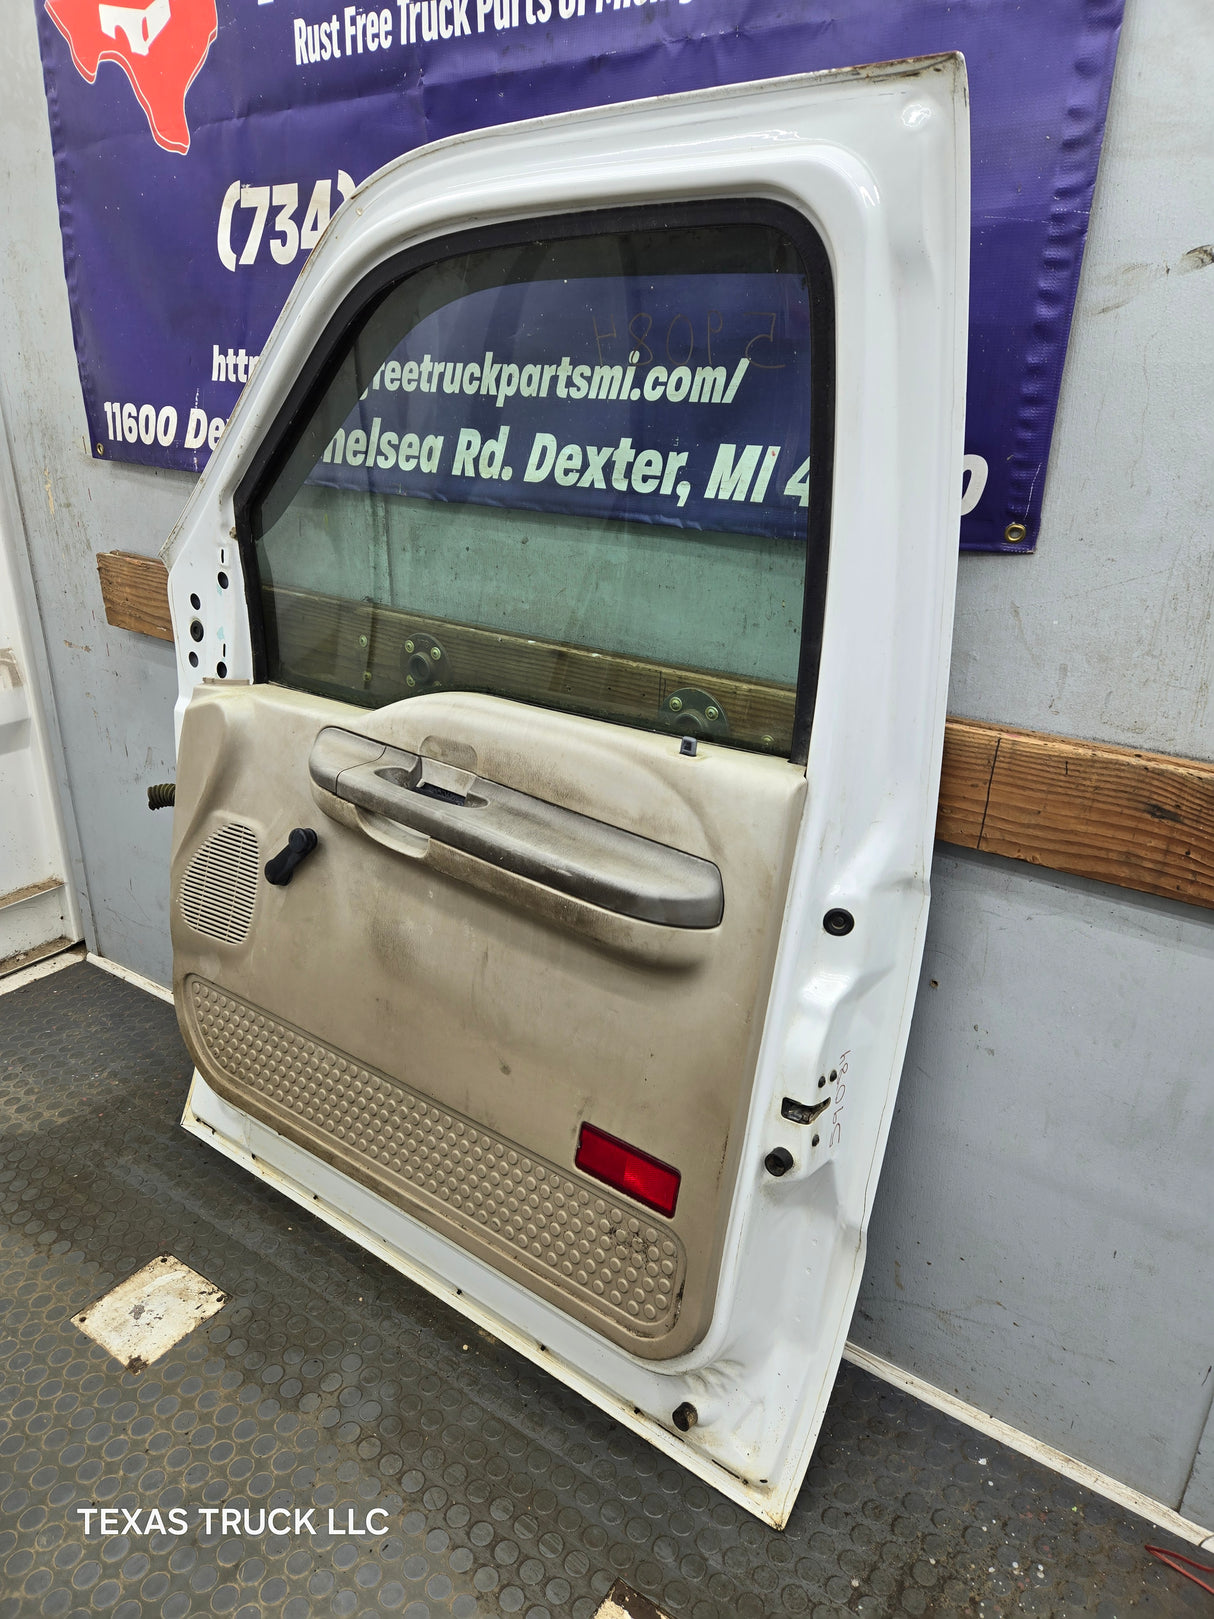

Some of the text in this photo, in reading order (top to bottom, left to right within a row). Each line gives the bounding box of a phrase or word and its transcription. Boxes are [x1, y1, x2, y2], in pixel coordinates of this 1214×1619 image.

[294, 17, 341, 65] Rust
[344, 6, 393, 56] Free
[397, 0, 472, 45] Truck
[477, 0, 552, 33] Parts
[359, 351, 750, 407] reetruckpartsmi.com/
[103, 401, 177, 447] 11600
[184, 408, 231, 451] De
[321, 417, 444, 473] helsea
[452, 425, 513, 481] Rd.
[523, 432, 691, 507] Dexter,
[704, 443, 781, 503] MI
